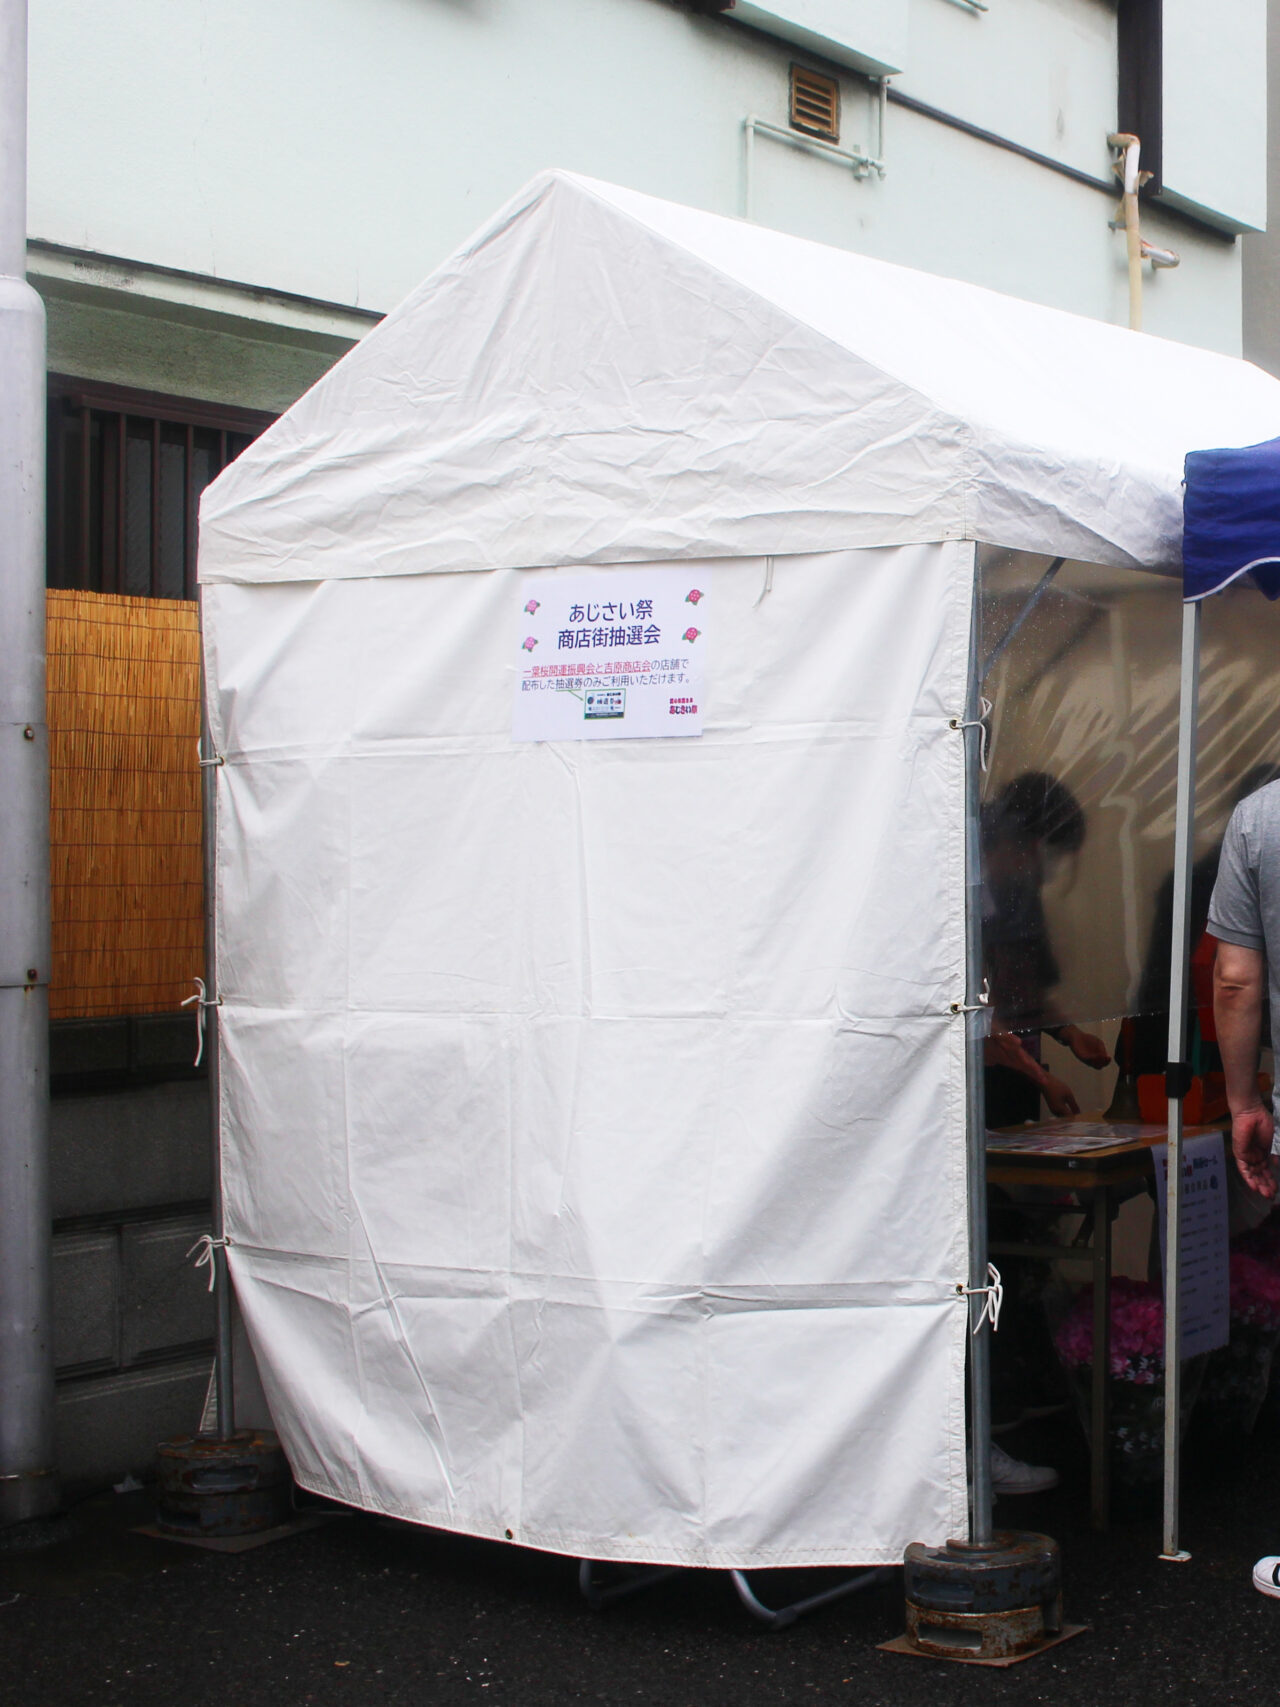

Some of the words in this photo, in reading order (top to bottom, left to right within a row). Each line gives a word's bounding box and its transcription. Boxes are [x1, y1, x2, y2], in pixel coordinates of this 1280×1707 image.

[569, 599, 654, 623] あじさい祭
[557, 624, 661, 650] 商店街抽選会
